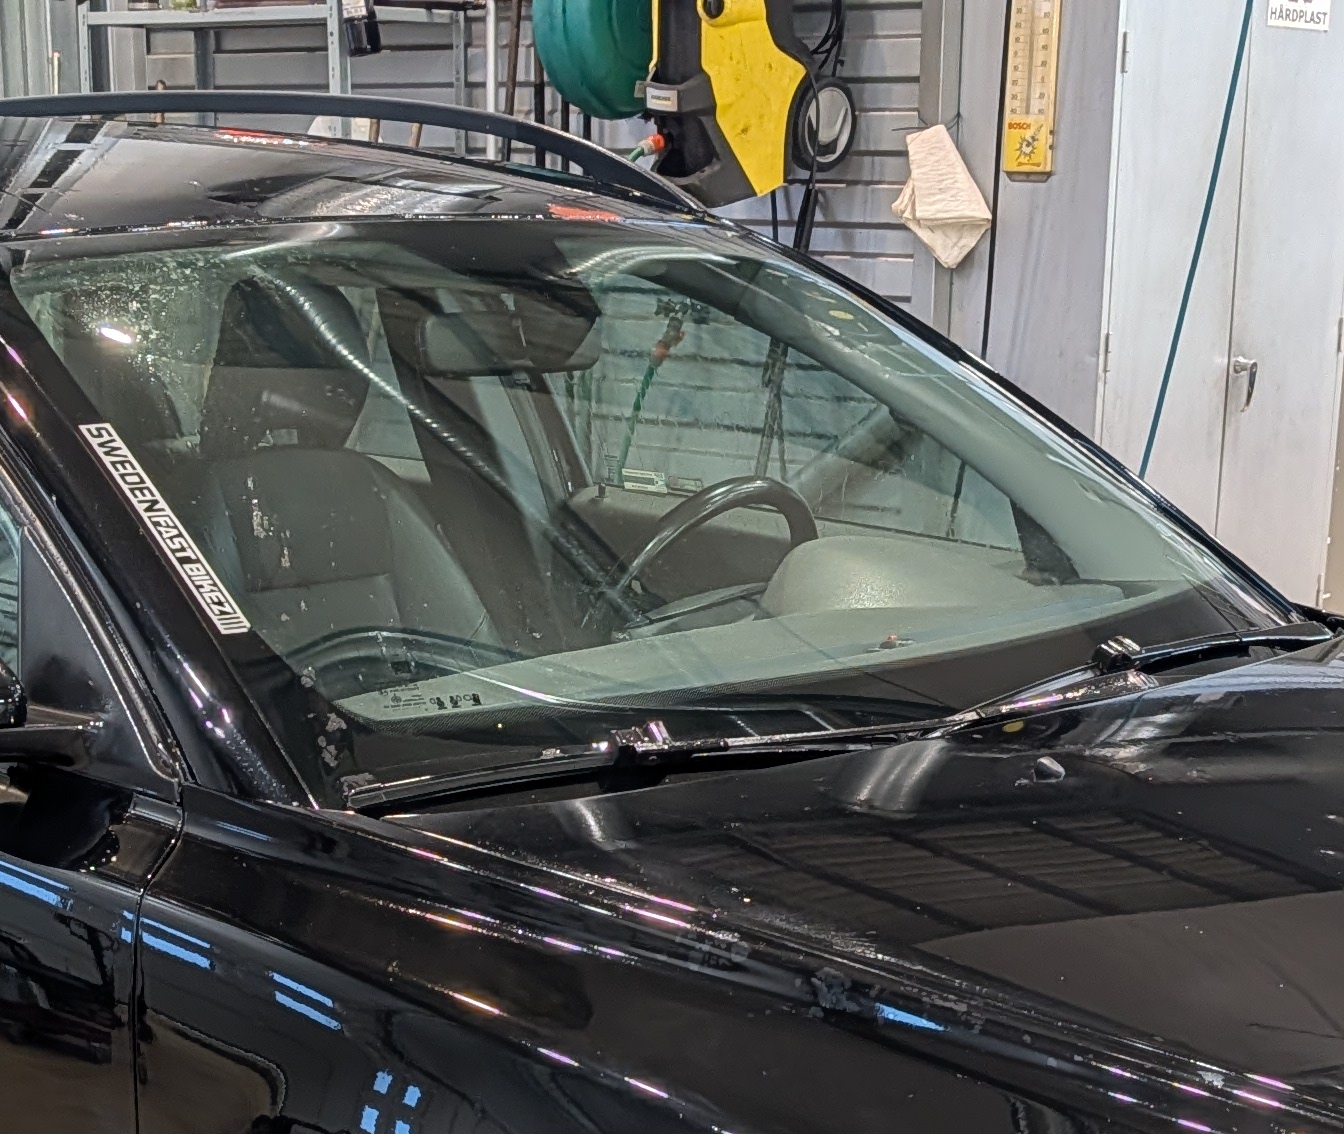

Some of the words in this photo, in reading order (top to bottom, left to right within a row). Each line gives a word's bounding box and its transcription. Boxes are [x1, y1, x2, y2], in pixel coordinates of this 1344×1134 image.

[1270, 4, 1328, 25] HÅRDPLAST
[1008, 122, 1031, 130] BOSCH
[86, 426, 166, 514] SWEDEN
[150, 515, 197, 560] FAST
[182, 563, 233, 616] BIKEZ
